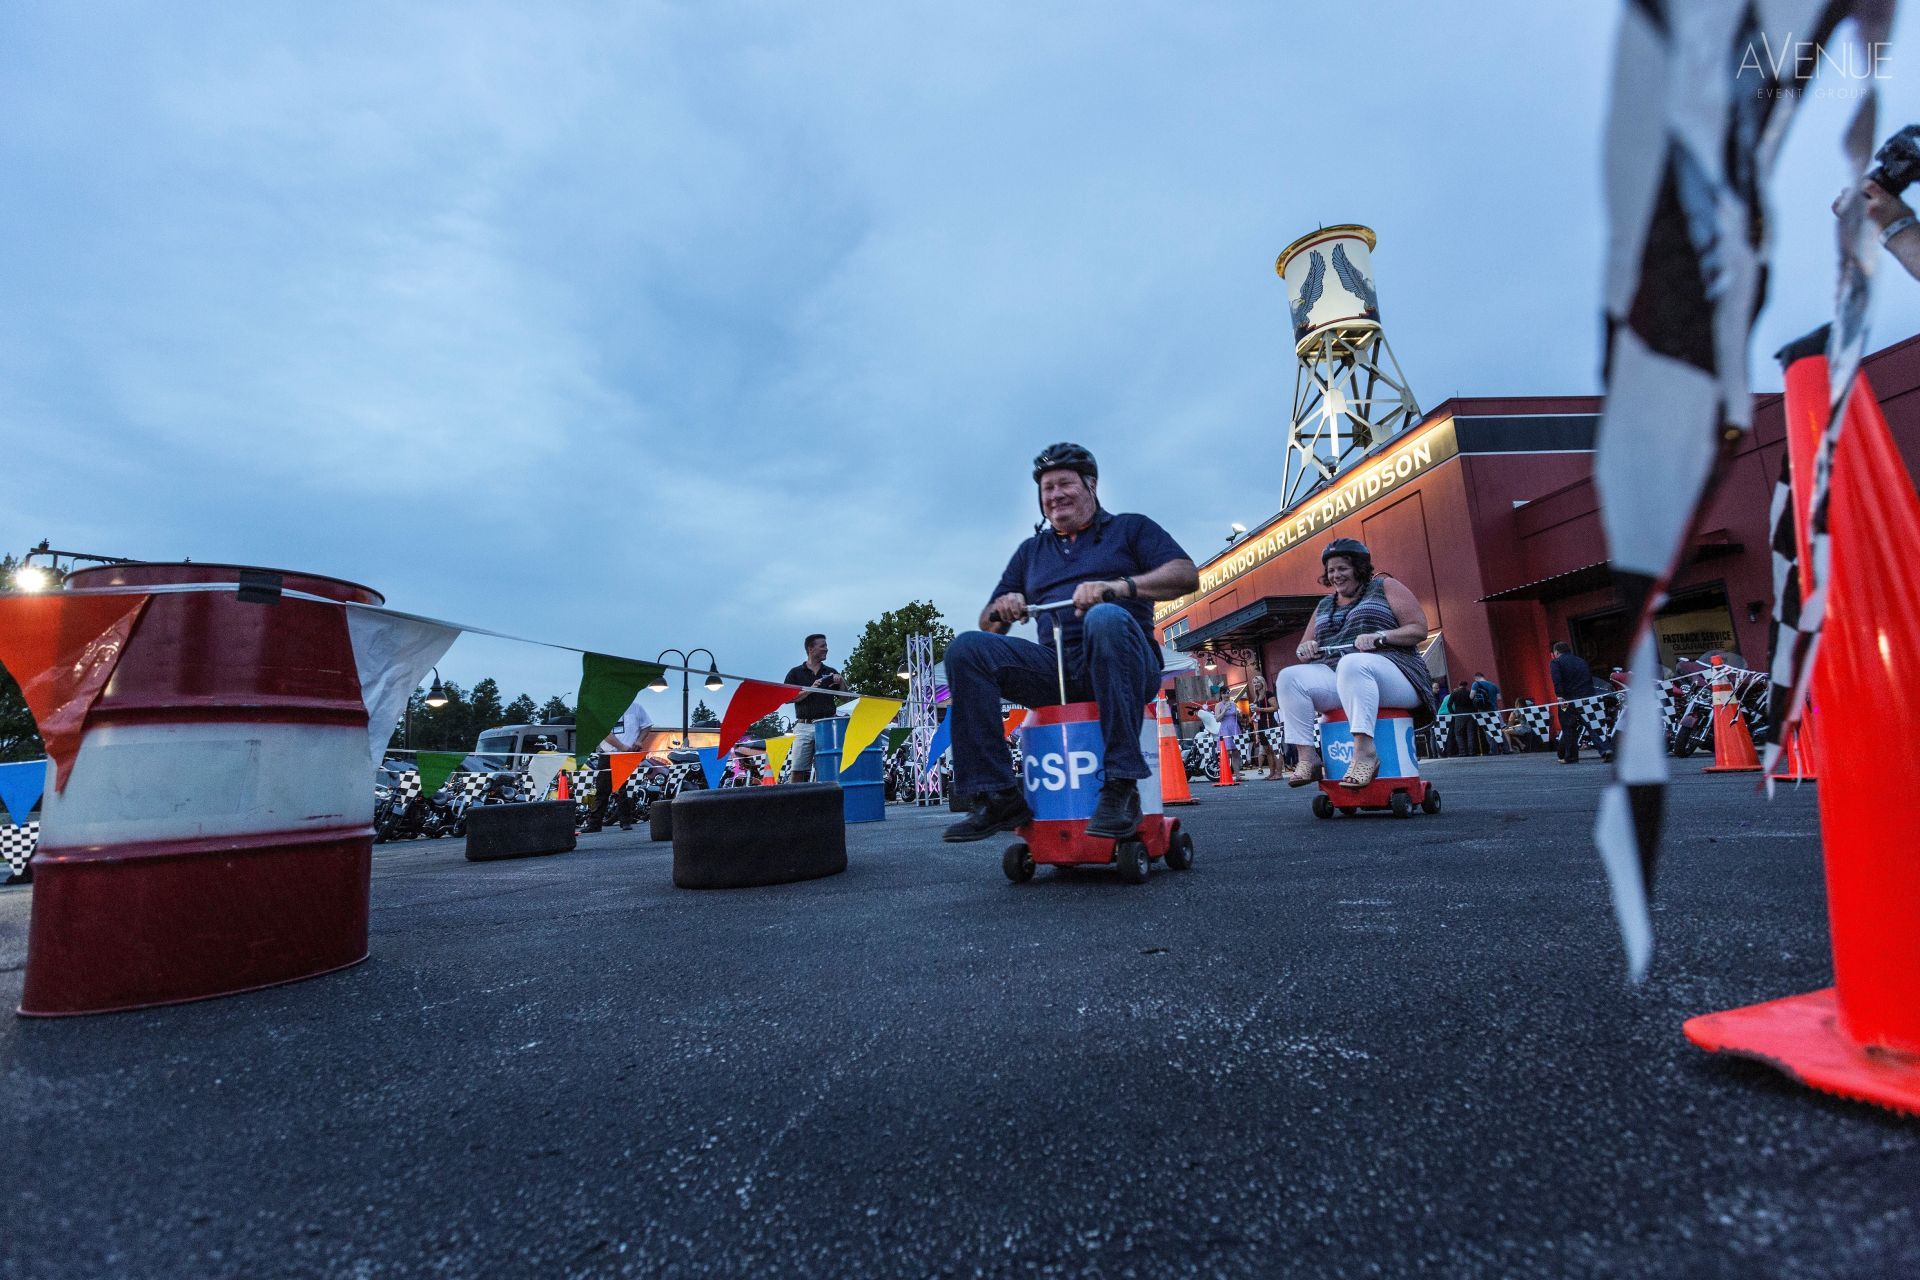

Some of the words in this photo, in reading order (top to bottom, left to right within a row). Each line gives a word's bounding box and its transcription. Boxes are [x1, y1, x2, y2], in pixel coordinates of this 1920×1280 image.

[1155, 596, 1185, 621] RENTALS
[1200, 549, 1255, 593] ORLANDO
[1257, 440, 1433, 562] HARLEY-DAVIDSON
[1672, 641, 1725, 651] GUARANTEE
[1701, 630, 1733, 642] SERVICE
[1024, 750, 1099, 793] CSP
